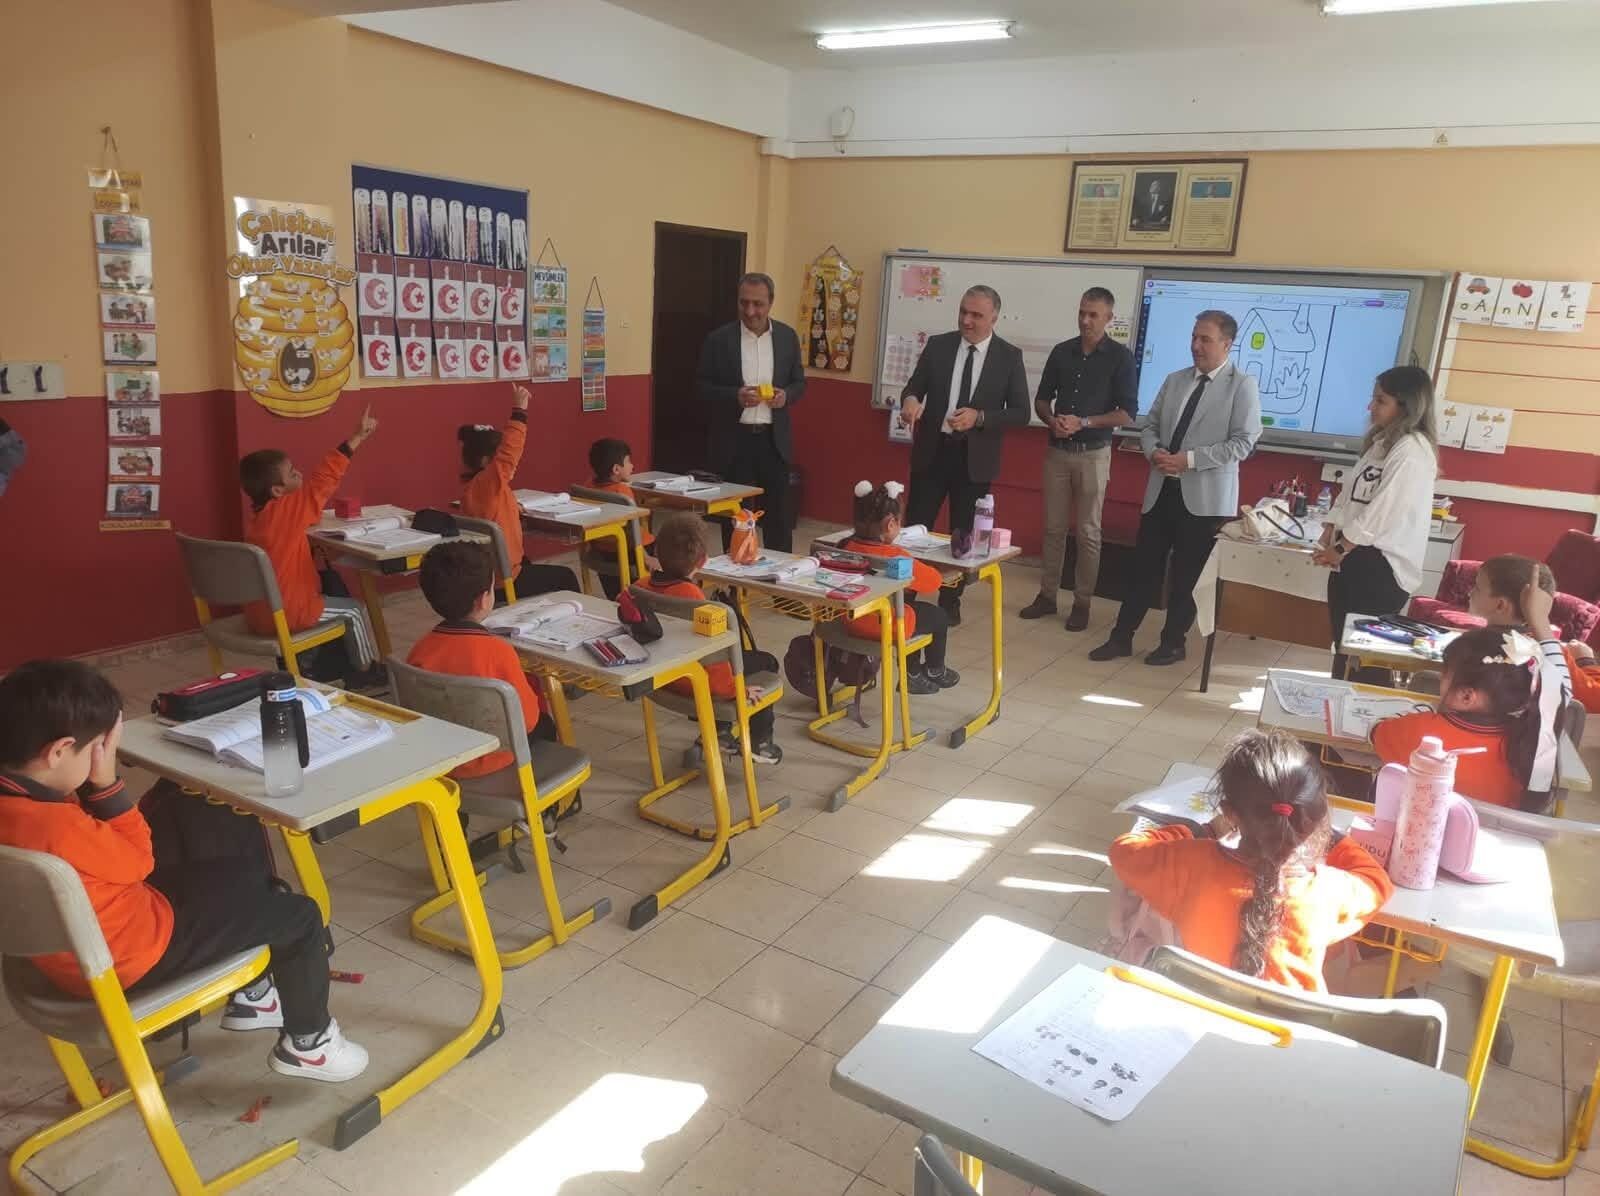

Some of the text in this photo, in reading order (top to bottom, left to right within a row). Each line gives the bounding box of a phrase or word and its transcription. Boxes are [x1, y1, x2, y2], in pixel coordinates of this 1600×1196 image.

[238, 208, 335, 242] Çalışkan
[261, 233, 328, 258] Arılar
[228, 255, 357, 284] Okur Yazarlar
[1474, 300, 1487, 313] A
[1502, 303, 1532, 317] n N
[1551, 306, 1577, 319] e E
[1481, 425, 1494, 438] 2
